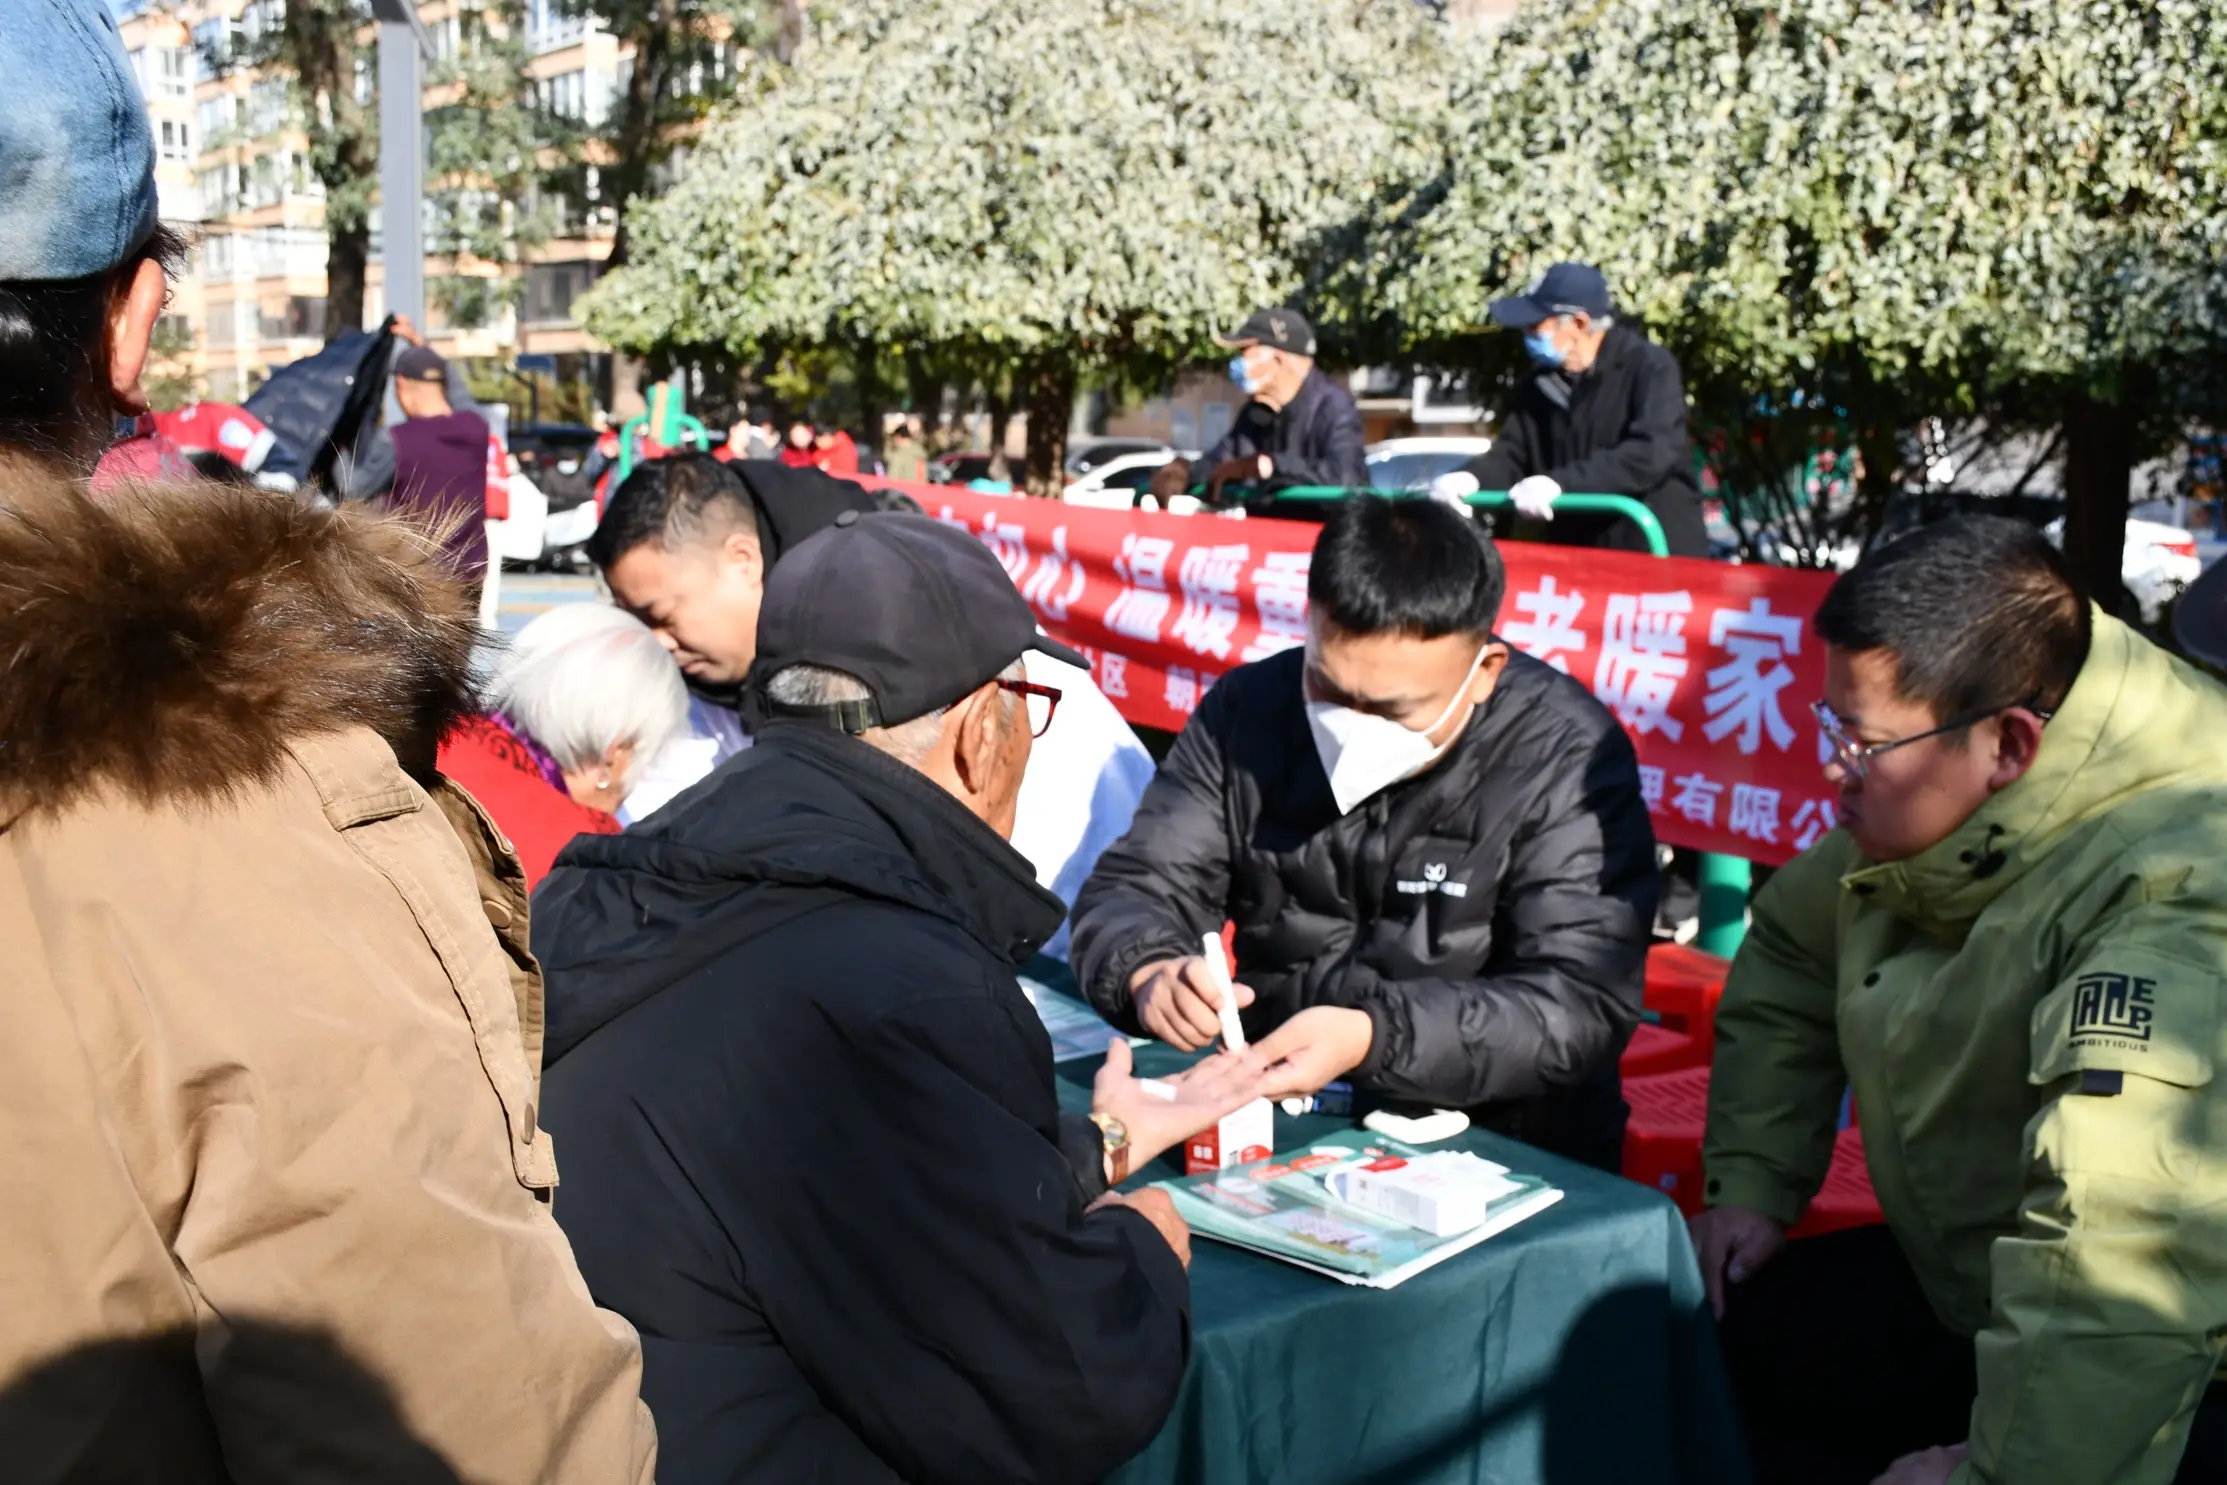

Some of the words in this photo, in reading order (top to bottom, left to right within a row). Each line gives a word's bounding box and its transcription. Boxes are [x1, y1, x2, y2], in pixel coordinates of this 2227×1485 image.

[938, 505, 1086, 621] 初心
[1501, 574, 1845, 766] 老暖家
[2067, 1038, 2148, 1053] AMBITIOUS
